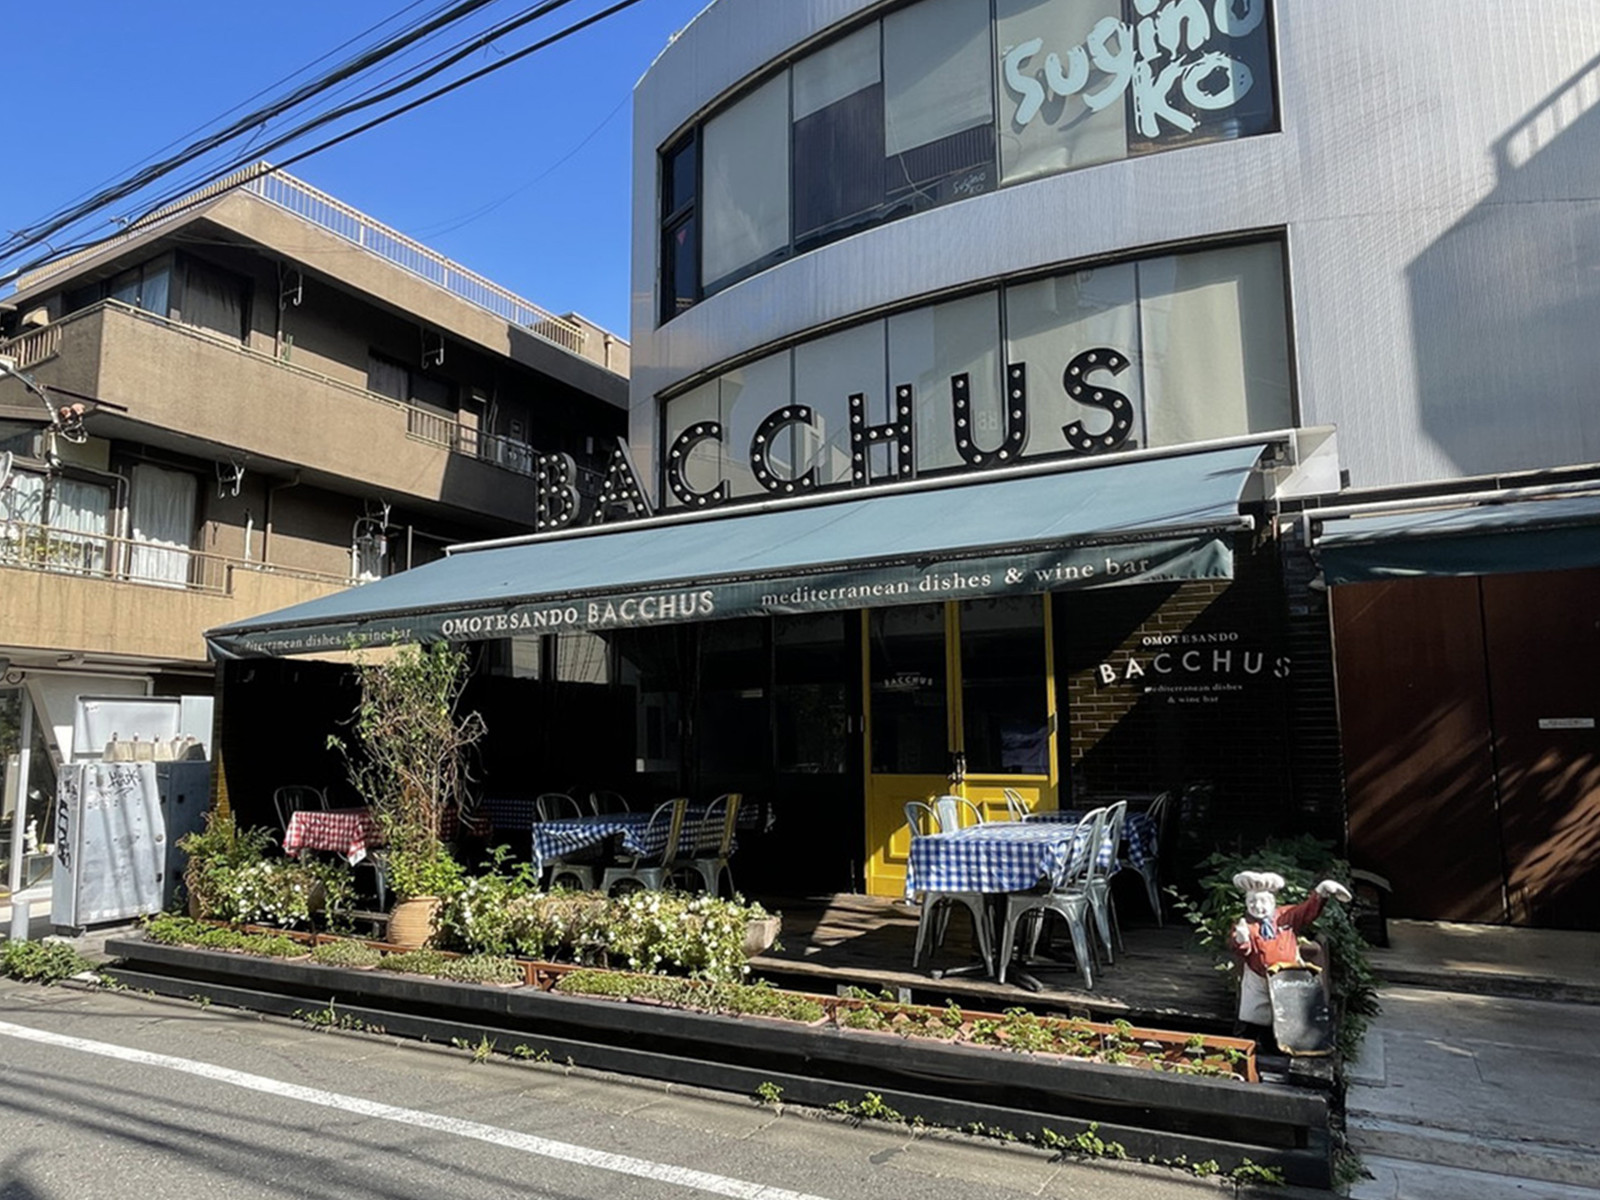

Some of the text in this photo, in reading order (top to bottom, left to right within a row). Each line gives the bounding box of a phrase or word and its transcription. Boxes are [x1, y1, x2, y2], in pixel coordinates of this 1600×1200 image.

[535, 347, 1134, 532] BACCHUS
[762, 557, 1149, 606] mediterranean dishes & wine bar
[442, 590, 715, 636] OMOTESANDO BACCHUS
[1142, 632, 1239, 646] OMOTESANDO
[1099, 650, 1291, 684] BACCHUS
